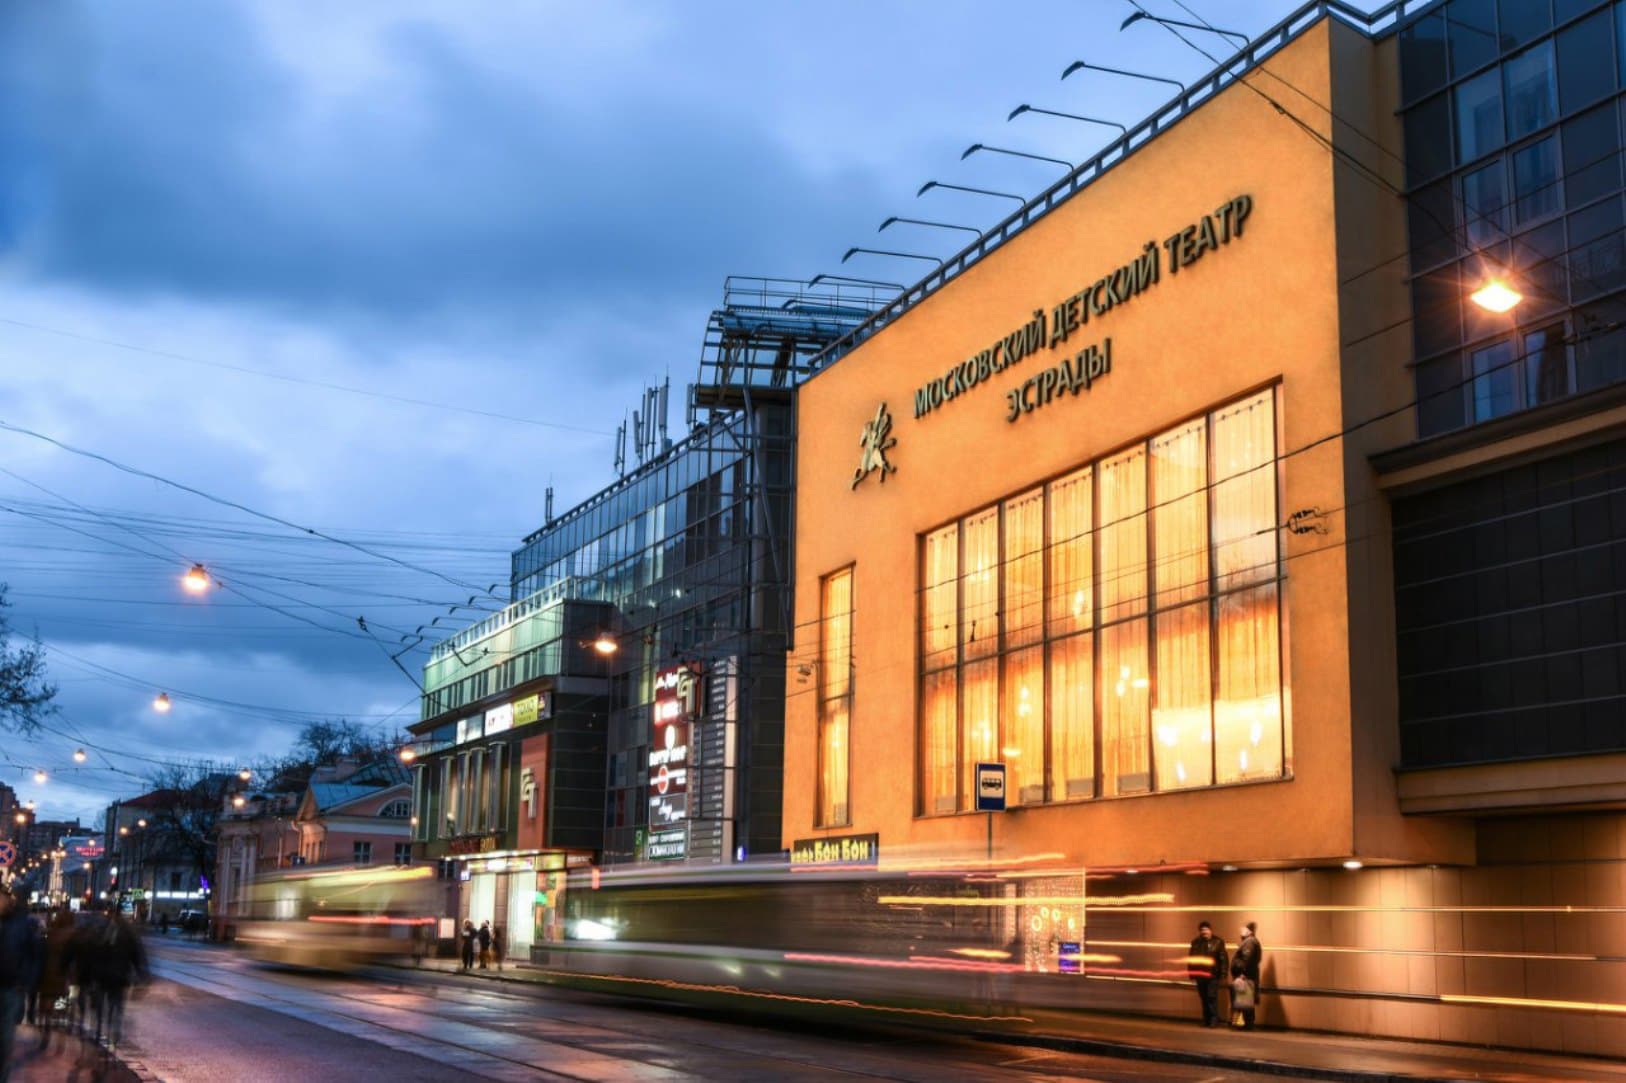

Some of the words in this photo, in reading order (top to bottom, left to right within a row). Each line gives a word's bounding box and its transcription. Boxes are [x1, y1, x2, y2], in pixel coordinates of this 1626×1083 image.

[913, 308, 1047, 420] МОСКОВСКИЙ
[1048, 240, 1160, 350] ДЕТСКИЙ
[1163, 194, 1253, 275] ТЕАТР
[1005, 337, 1113, 422] ЭСТРАДЫ
